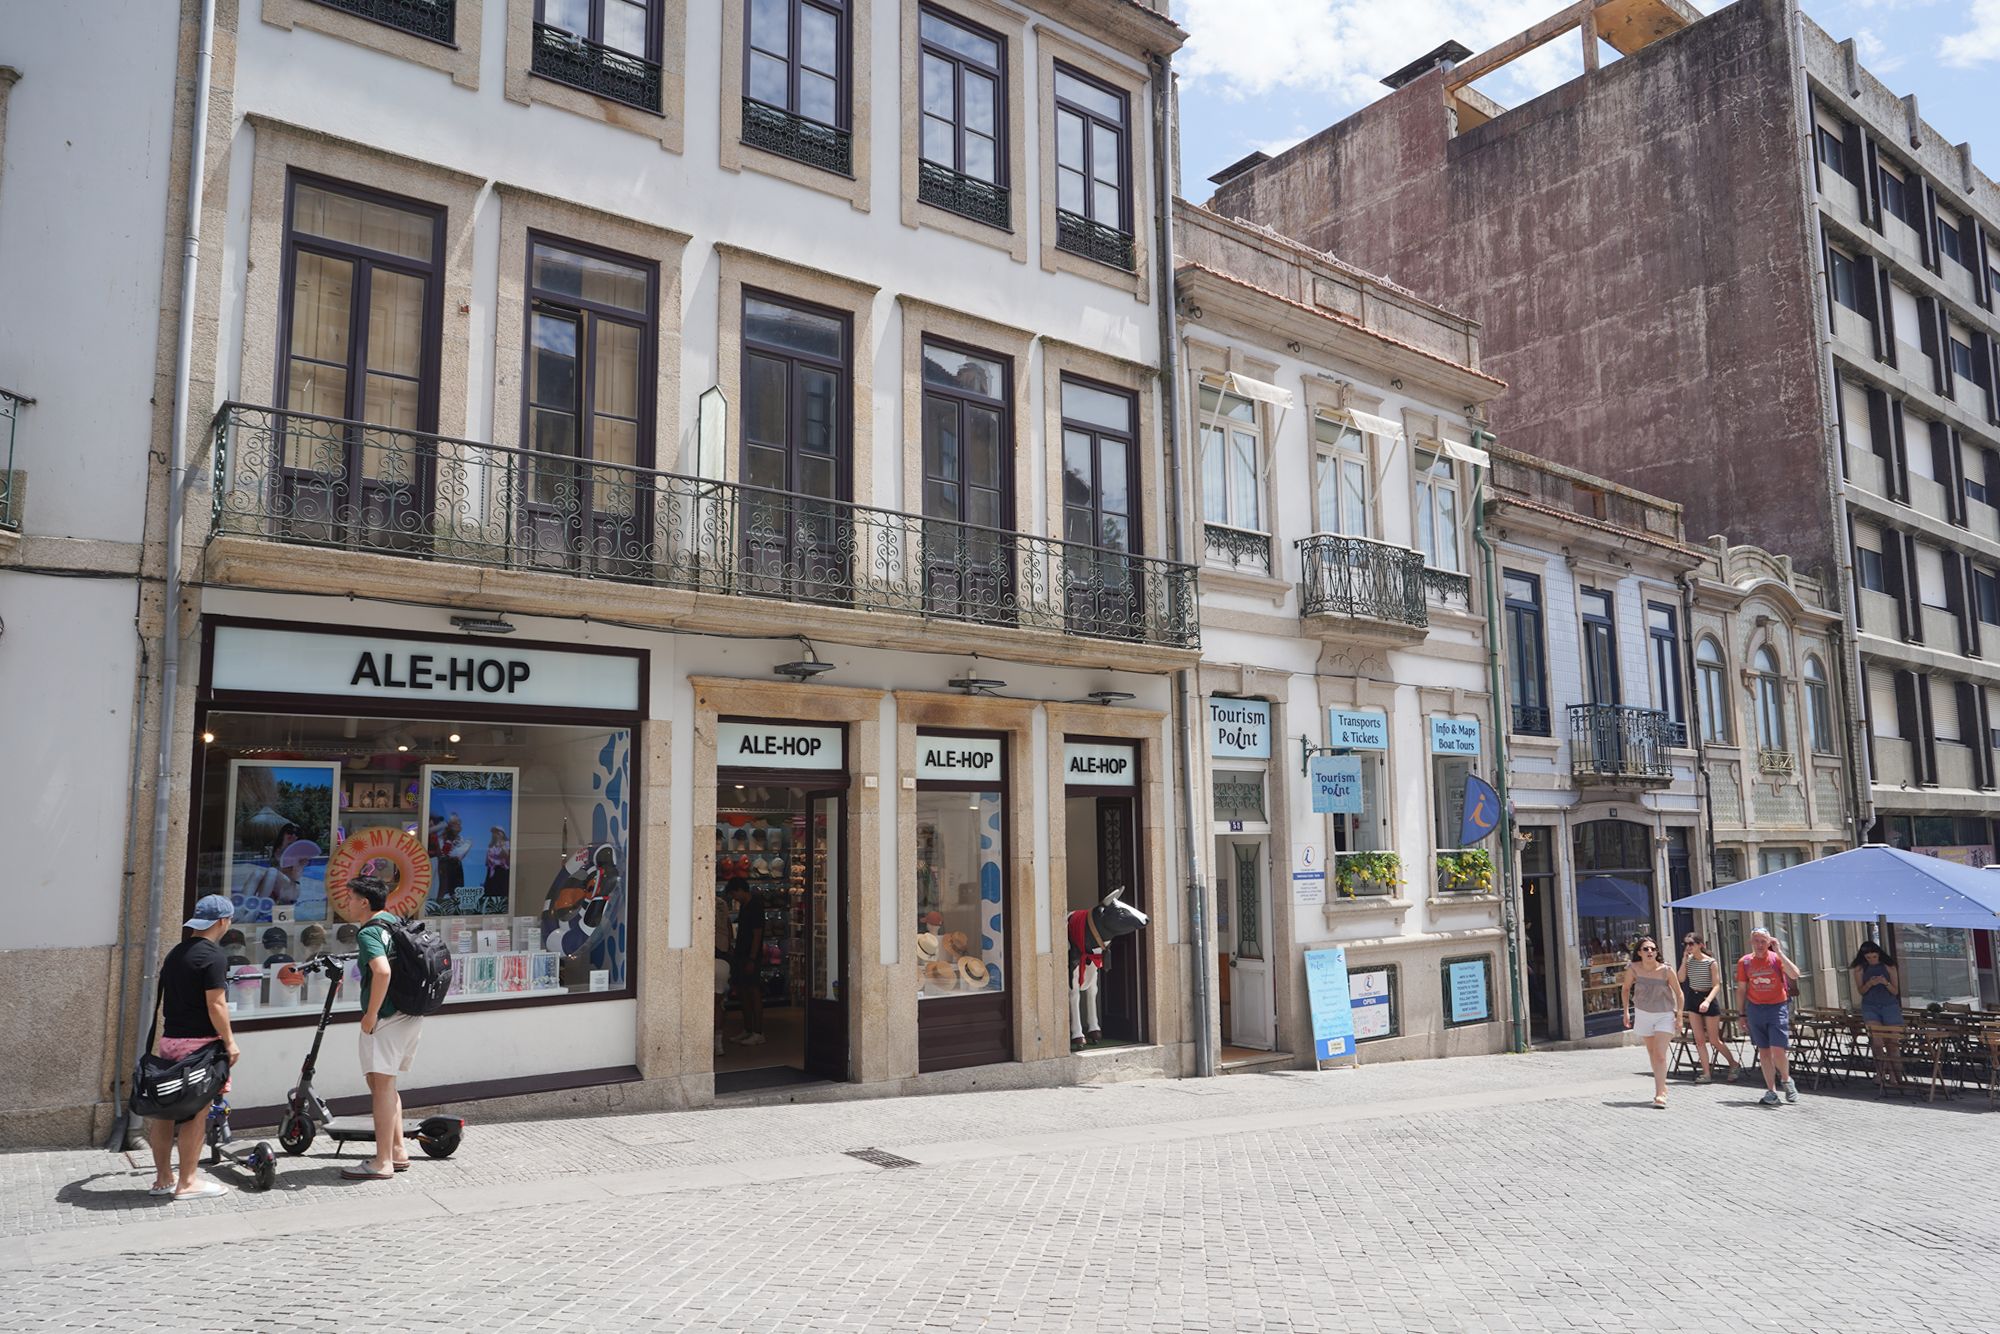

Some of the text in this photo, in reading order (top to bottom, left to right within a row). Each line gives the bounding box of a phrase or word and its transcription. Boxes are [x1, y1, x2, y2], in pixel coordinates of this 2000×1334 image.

[351, 652, 530, 693] ALE-HOP
[1210, 705, 1266, 725] Tourism
[1338, 715, 1382, 729] Transports
[1219, 727, 1258, 750] Point
[1343, 731, 1379, 744] & Tickets
[1436, 723, 1476, 738] Info & Maps
[739, 735, 821, 756] ALE-HOP
[1438, 738, 1475, 750] Boat Tours
[925, 749, 994, 768] ALE-HOP
[1070, 757, 1127, 774] ALE-HOP
[1315, 772, 1356, 782] Tourism
[1321, 784, 1350, 797] Point
[369, 829, 394, 846] MY
[396, 833, 430, 897] FAVORITE
[456, 888, 483, 896] SUMMER
